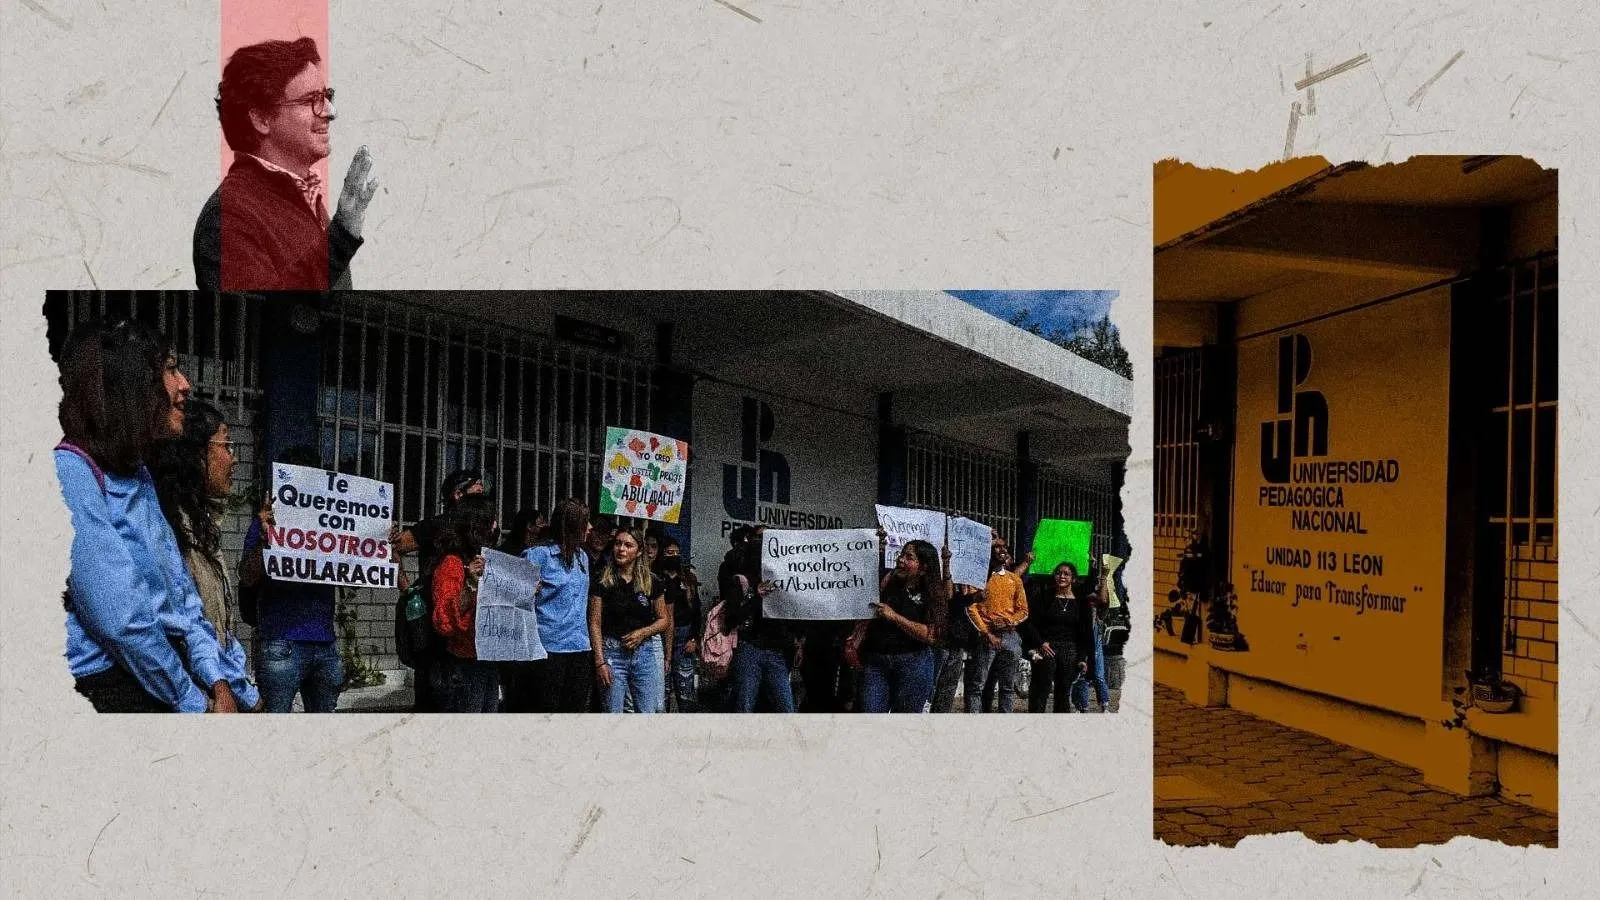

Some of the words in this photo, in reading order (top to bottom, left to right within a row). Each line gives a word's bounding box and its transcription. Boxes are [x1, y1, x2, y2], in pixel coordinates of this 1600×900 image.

[639, 452, 650, 460] YO
[655, 454, 670, 463] CREO
[326, 471, 348, 493] Te
[1293, 459, 1400, 484] UNIVERSIDAD
[278, 484, 390, 519] Queremos
[1259, 486, 1344, 508] PEDAGOGICA
[318, 513, 355, 531] con
[758, 507, 842, 530] UNIVERSIDAD
[1292, 510, 1368, 534] NACIONAL
[267, 524, 388, 559] NOSOTROS
[768, 537, 839, 558] Queremos
[847, 539, 873, 551] con
[267, 555, 395, 586] ABULARACH
[1266, 547, 1311, 569] UNIDAD
[1317, 551, 1337, 571] 113
[1343, 553, 1383, 576] LEON
[785, 575, 865, 592] Abularach
[1292, 583, 1321, 607] para
